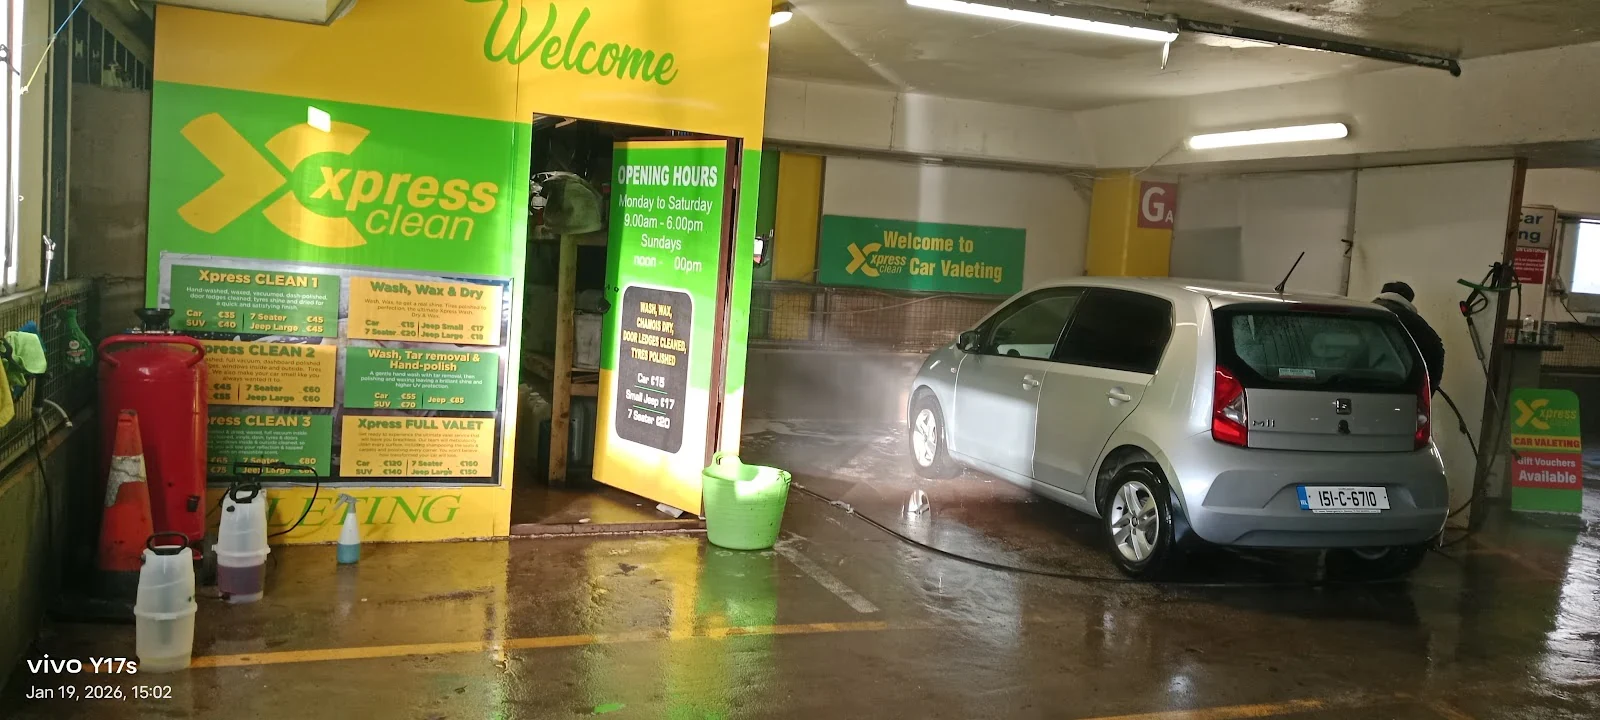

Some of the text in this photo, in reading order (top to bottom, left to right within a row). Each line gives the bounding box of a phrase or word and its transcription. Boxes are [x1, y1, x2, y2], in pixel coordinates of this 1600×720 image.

[464, 0, 679, 86] Welcome
[618, 164, 718, 187] OPENING HOURS
[309, 166, 499, 213] xpress
[618, 194, 713, 215] Monday to Saturday
[365, 204, 474, 241] clean
[624, 213, 658, 228] 9.00am
[666, 215, 704, 233] 6.00pm
[640, 233, 682, 253] Sundays
[883, 230, 974, 254] Welcome to
[633, 255, 657, 267] noon
[870, 254, 907, 267] xpress
[879, 263, 902, 274] clean
[909, 257, 1003, 284] Car Valeting
[199, 270, 319, 288] Xpress CLEAN 1
[370, 280, 484, 300] Wash, Wax & Dry
[186, 309, 235, 319] Car €35
[640, 301, 658, 317] WASH,
[186, 319, 236, 328] SUV €40
[250, 312, 324, 323] 7 Seater €45
[365, 319, 379, 327] Car
[250, 322, 324, 333] Jeep Large €45
[421, 322, 484, 332] Jeep Small €17
[636, 316, 661, 332] CHAMOIS
[372, 328, 397, 336] Seater
[400, 329, 416, 337] €20
[421, 331, 440, 339] Jeep
[442, 332, 464, 340] Large
[622, 329, 686, 354] DOOR LEDGES CLEANED,
[204, 344, 316, 358] press CLEAN 2
[368, 348, 480, 363] Wash, Tar removal &
[631, 346, 676, 367] TYRES POLISHED
[390, 360, 457, 372] Hand-polish
[637, 372, 665, 388] Car €15
[246, 383, 252, 391] 7
[254, 384, 283, 392] Seater
[246, 393, 321, 403] Jeep Large €60
[400, 392, 416, 400] €55
[427, 396, 465, 404] Jeep €85
[625, 388, 675, 410] Small Jeep €17
[373, 400, 391, 408] SUV
[627, 408, 671, 429] 7 Seater €20
[1540, 408, 1577, 420] xpress
[245, 415, 298, 427] CLEAN
[302, 415, 311, 427] 3
[358, 418, 484, 430] Xpress FULL VALET
[1513, 437, 1580, 448] CAR VALETING
[299, 457, 317, 465] €80
[1535, 457, 1576, 468] Vouchers
[211, 466, 227, 474] €75
[1518, 469, 1577, 484] Available
[1318, 490, 1377, 507] 151-C-6710
